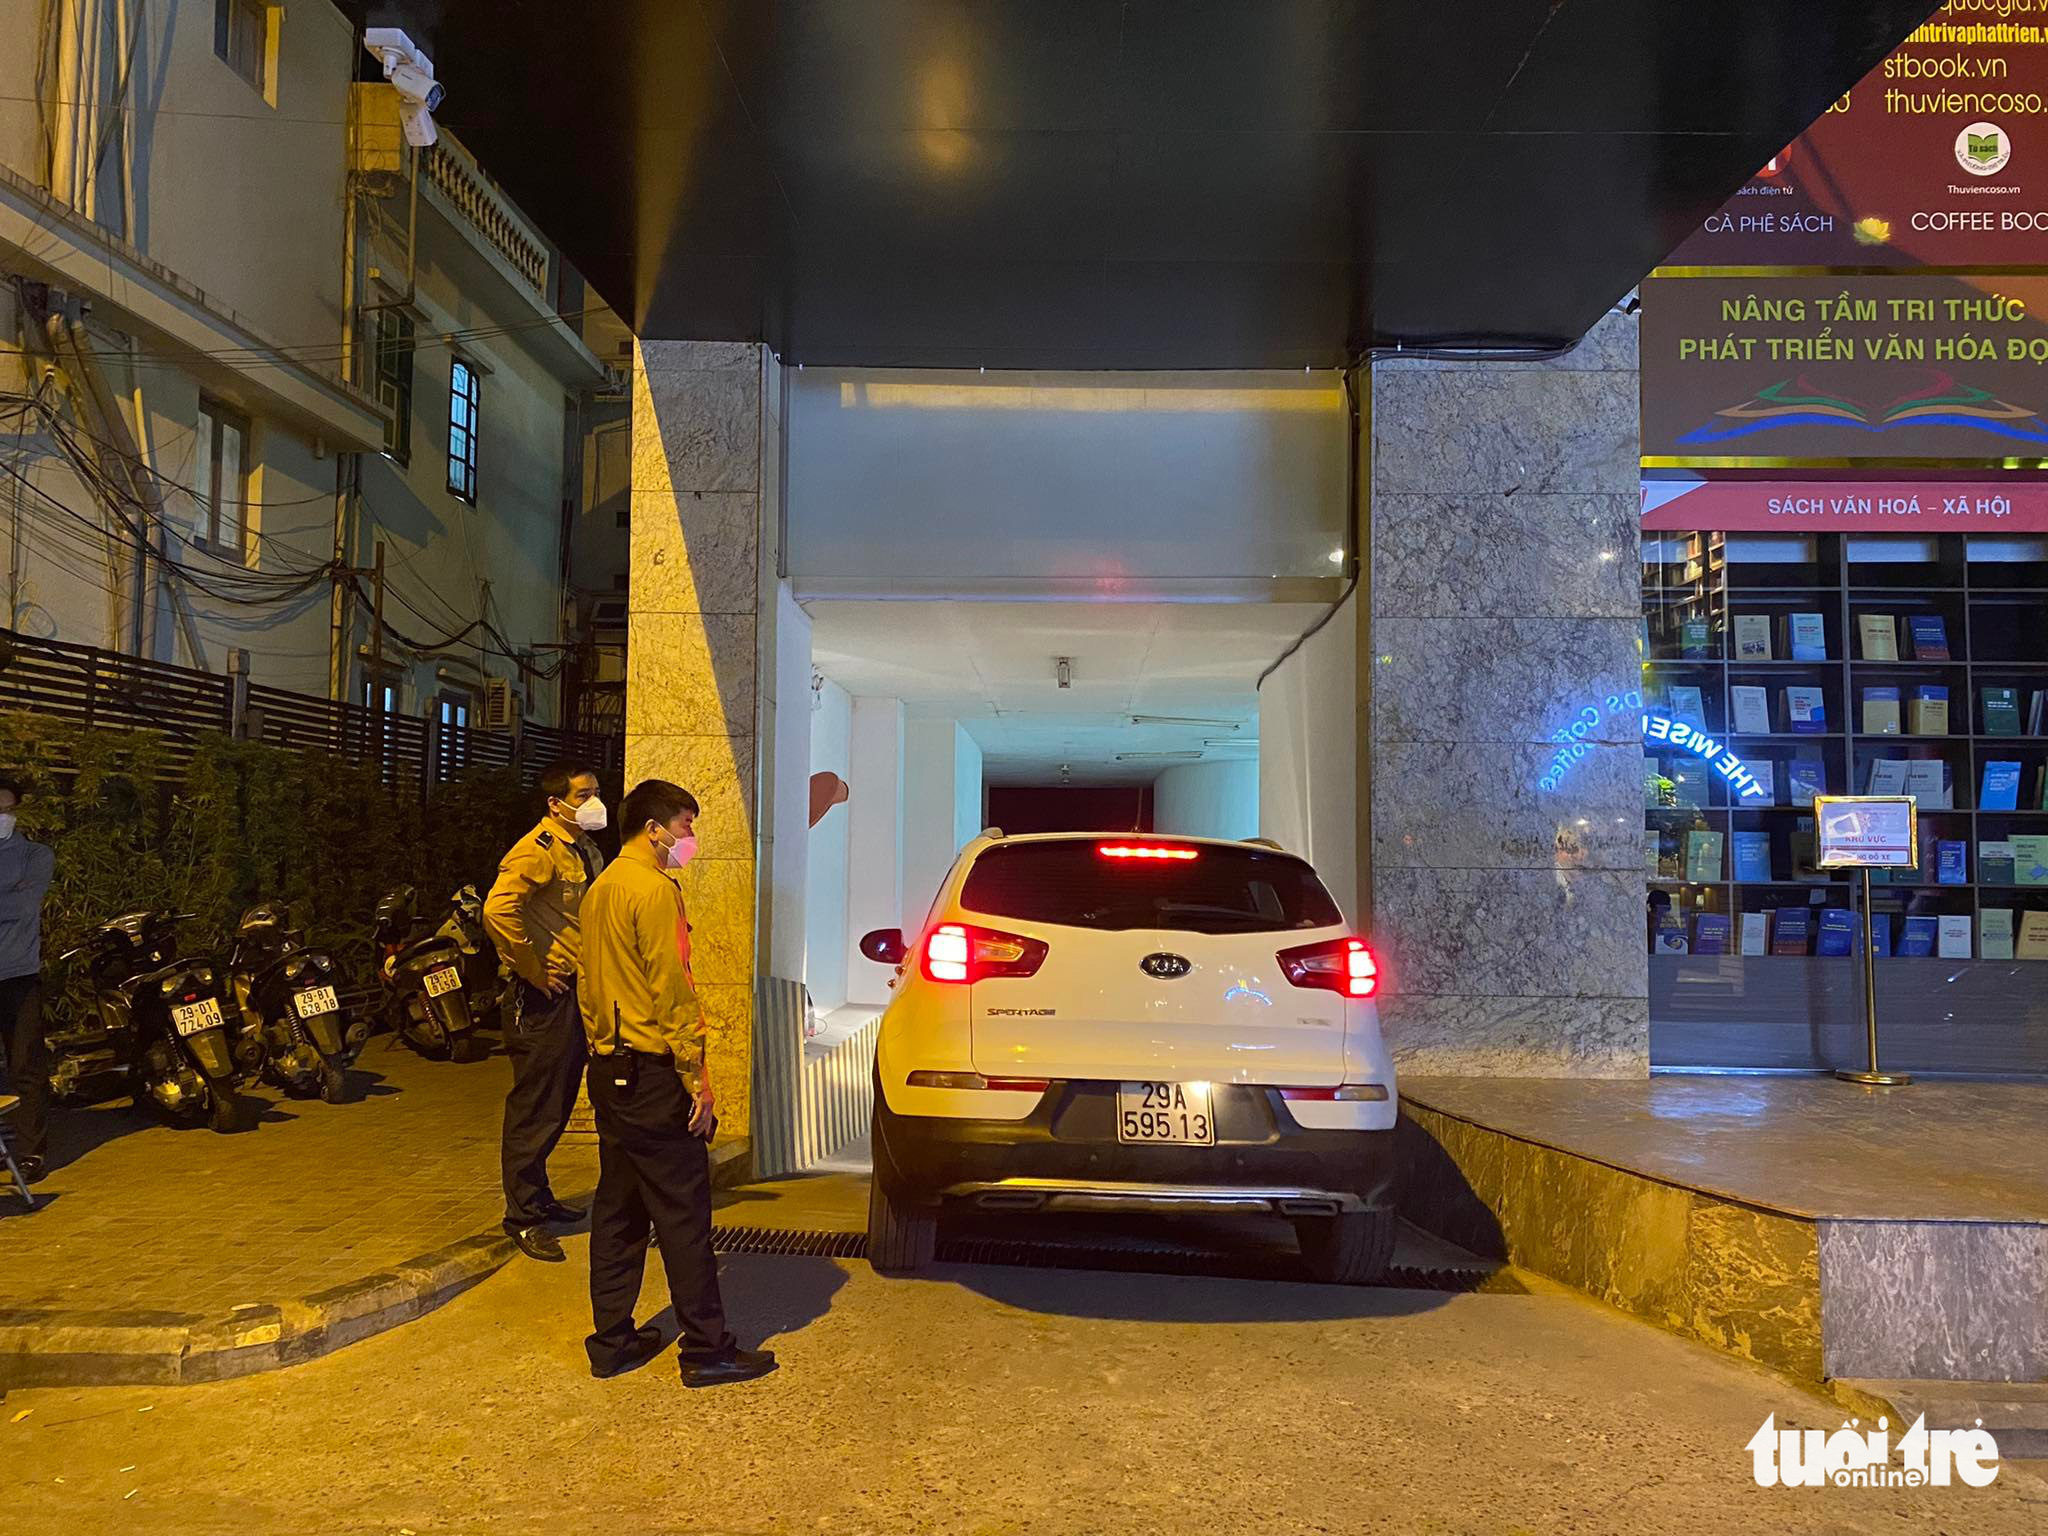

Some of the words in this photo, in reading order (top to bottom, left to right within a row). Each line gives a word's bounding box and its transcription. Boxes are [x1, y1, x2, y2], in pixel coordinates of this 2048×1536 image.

[1884, 52, 2007, 78] stbook.vn
[1884, 87, 2048, 114] thuviencoso.
[1760, 185, 1781, 196] điện
[1947, 184, 2021, 194] Thuviencoso.vn
[1704, 212, 1735, 233] CÀ
[1740, 212, 1775, 233] PHÊ
[1780, 211, 1834, 233] SÁCH
[1911, 211, 1995, 231] COFFEE
[1721, 293, 1806, 322] NÂNG
[1815, 290, 1877, 321] TẦM
[1887, 299, 1935, 321] TRI
[1943, 293, 2025, 322] THỨC
[1679, 332, 1757, 360] PHÁT
[1765, 326, 1855, 360] TRIỂN
[1864, 332, 1924, 360] VĂN
[1935, 332, 1998, 361] HÓA
[1768, 495, 1824, 514] SÁCH
[1830, 495, 1871, 514] VĂN
[1878, 495, 1921, 514] HOÁ
[1943, 495, 1970, 514] XÃ
[1976, 495, 2010, 517] HỘI
[1150, 958, 1184, 973] KIA
[180, 1012, 222, 1034] 724.09
[987, 1008, 1056, 1017] SPORTAGE
[1141, 1083, 1188, 1110] 29A
[1124, 1111, 1209, 1140] 595.13
